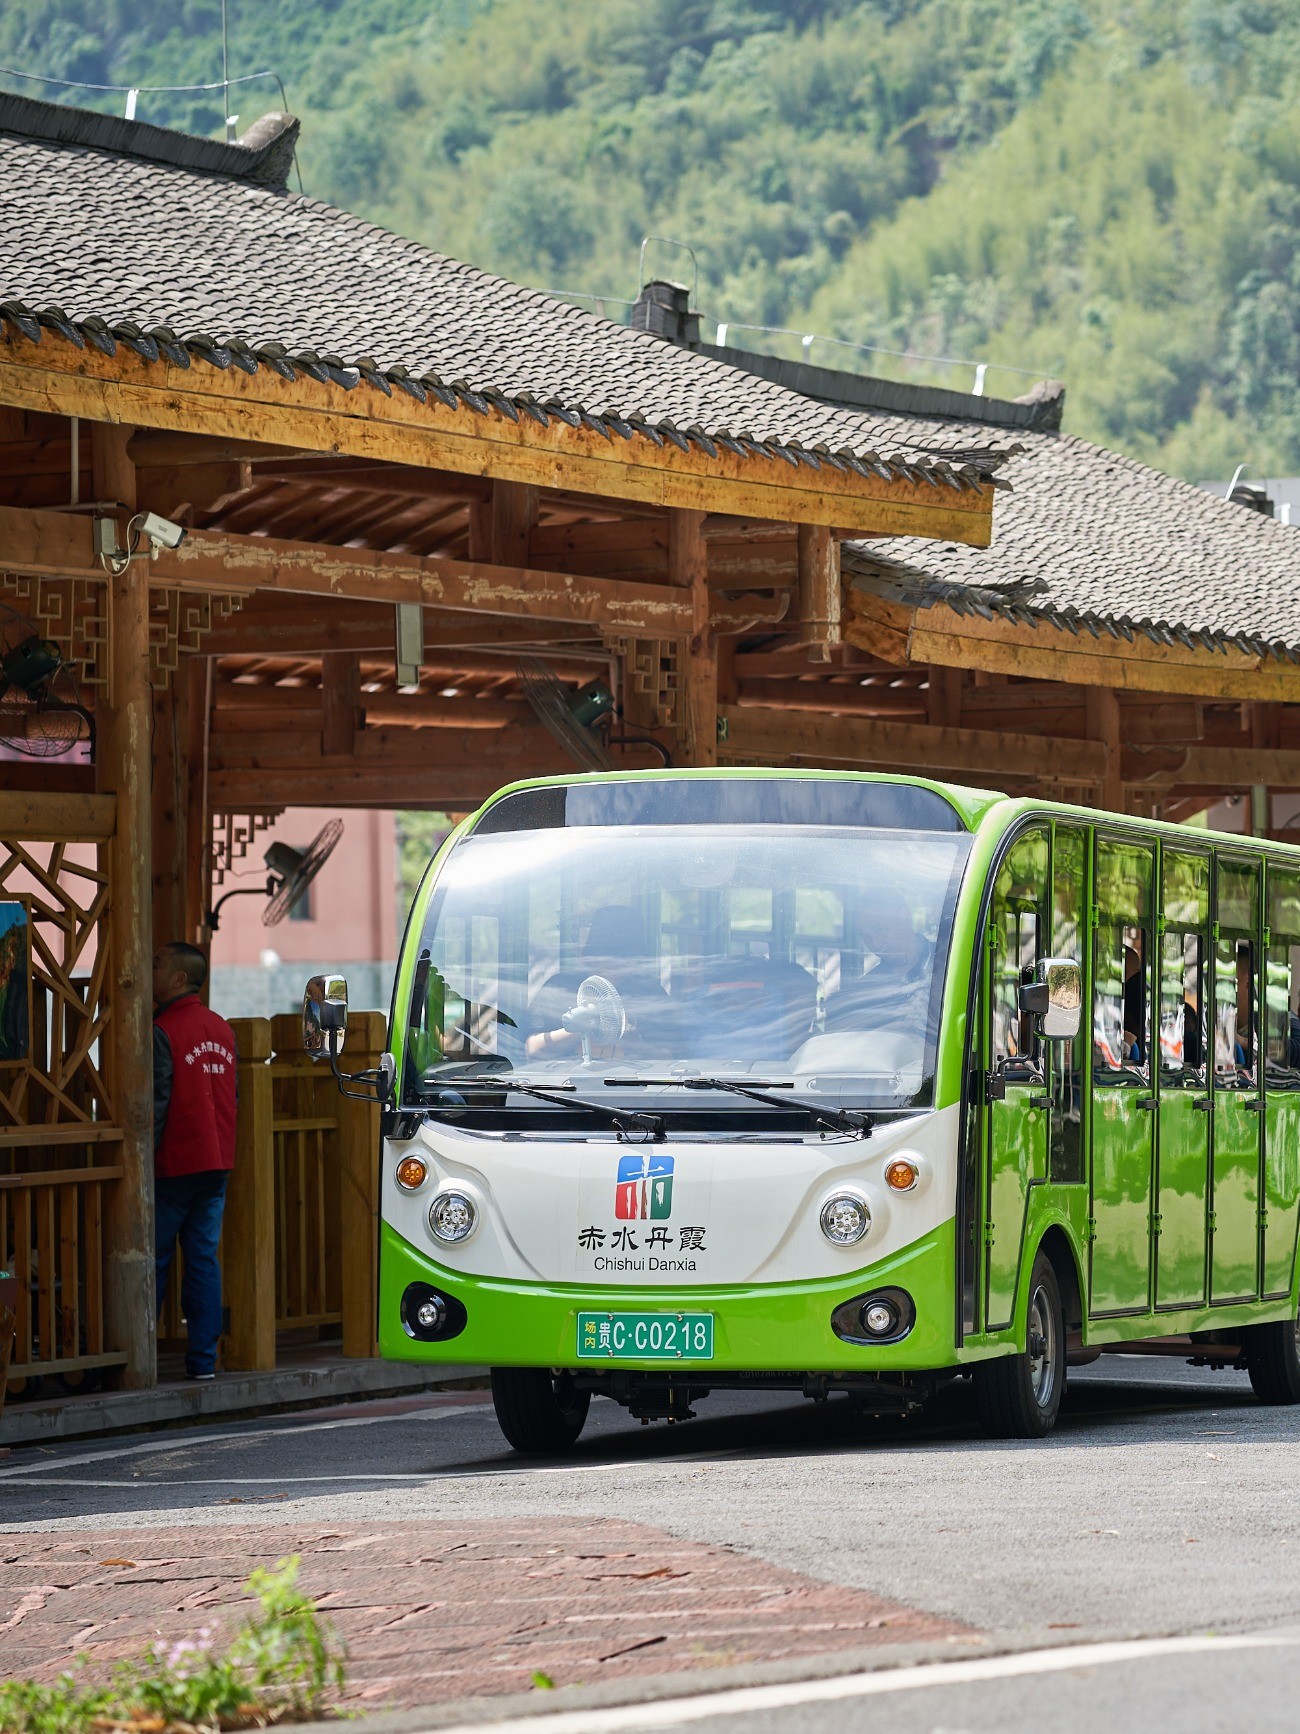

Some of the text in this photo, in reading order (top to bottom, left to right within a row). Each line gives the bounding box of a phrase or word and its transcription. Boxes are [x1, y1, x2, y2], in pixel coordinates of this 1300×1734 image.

[203, 1063, 225, 1074] 为服务
[578, 1226, 707, 1251] 赤水丹霞
[594, 1257, 696, 1271] Chishui Danxia
[584, 1321, 596, 1349] 场内
